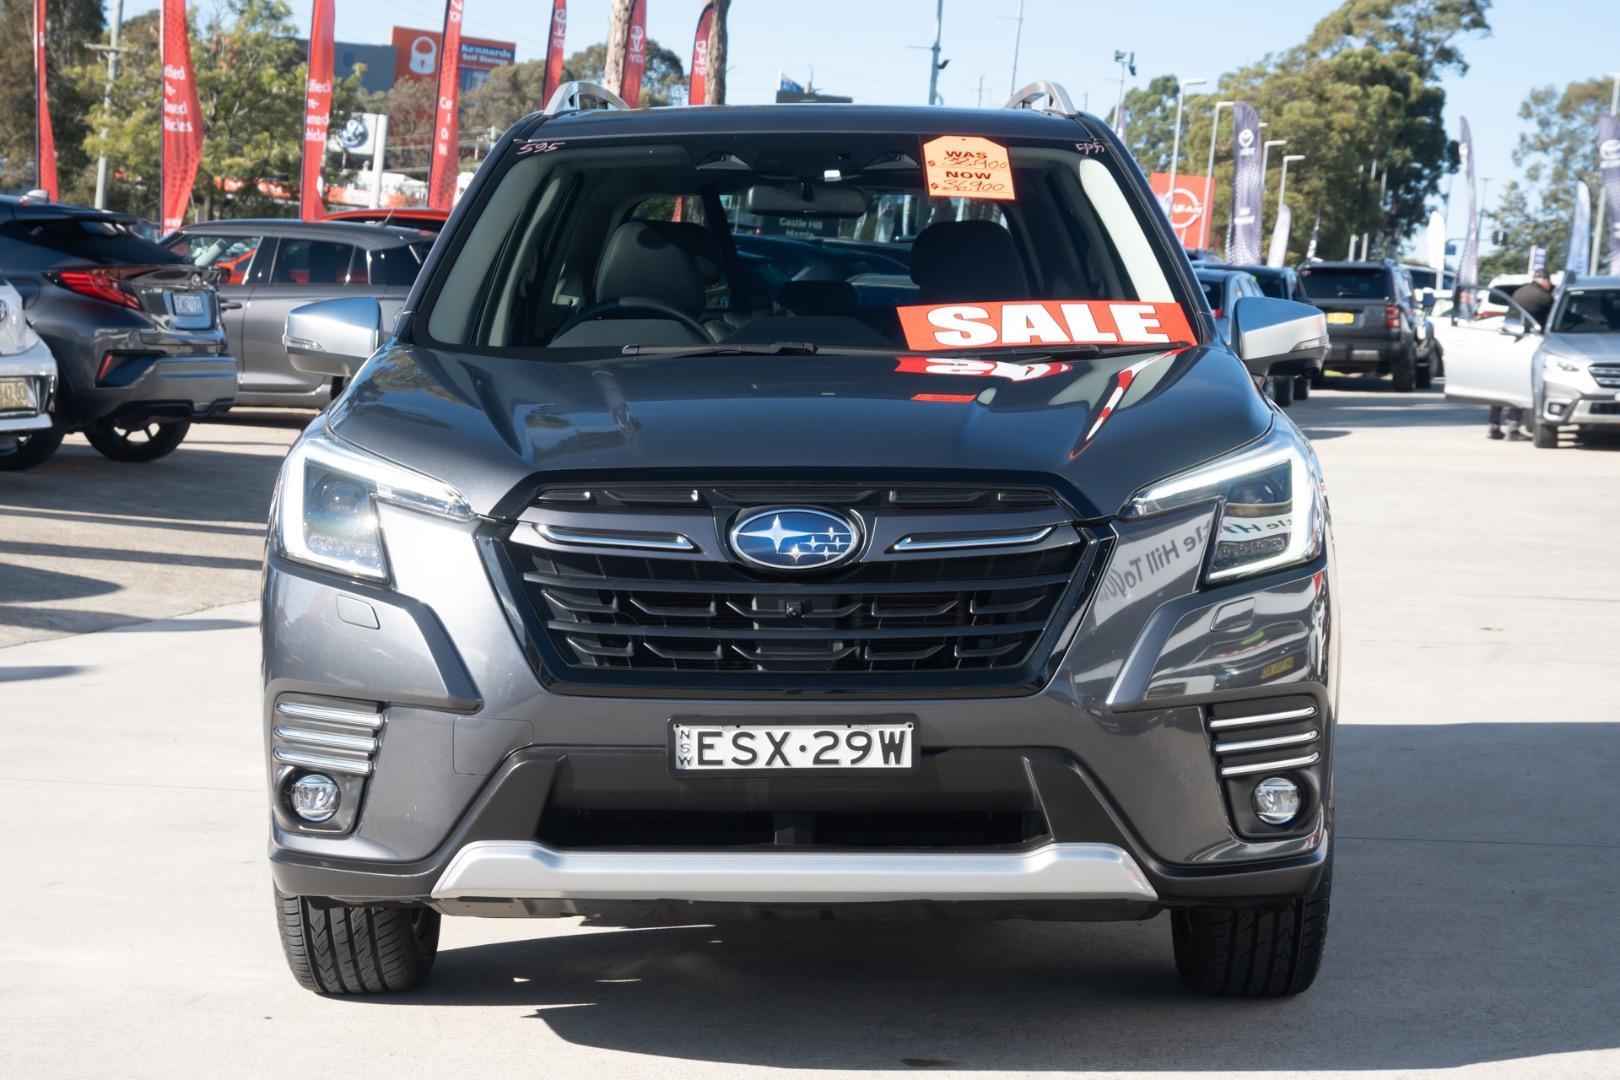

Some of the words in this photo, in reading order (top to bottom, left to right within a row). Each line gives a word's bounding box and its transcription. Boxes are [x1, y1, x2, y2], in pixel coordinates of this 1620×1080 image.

[461, 43, 512, 57] Kennards
[516, 142, 566, 154] 595
[945, 151, 988, 159] WAS
[945, 171, 992, 180] NOW
[779, 217, 807, 228] Castle
[808, 219, 823, 229] Hill
[926, 303, 1170, 346] SALE
